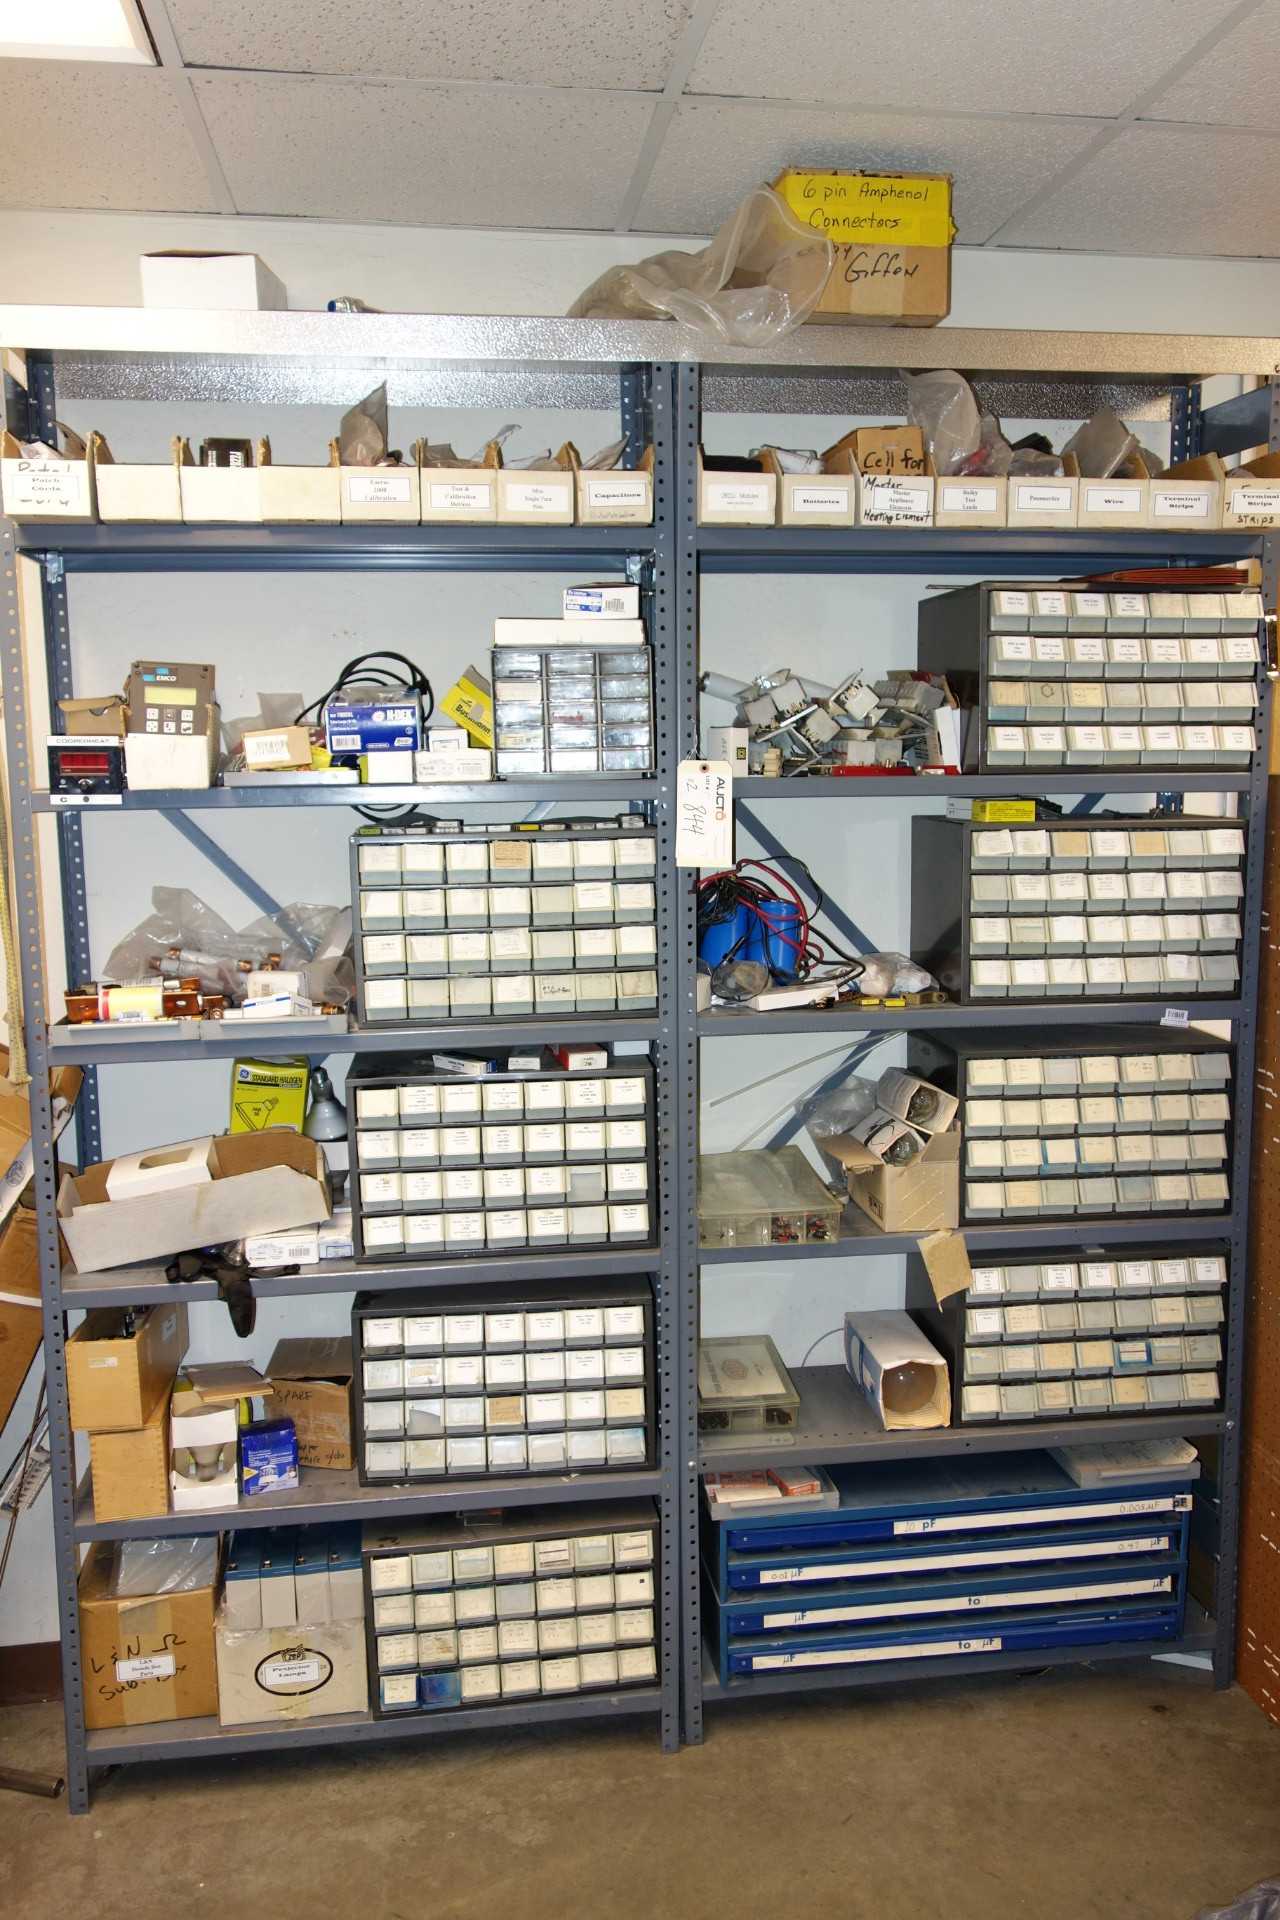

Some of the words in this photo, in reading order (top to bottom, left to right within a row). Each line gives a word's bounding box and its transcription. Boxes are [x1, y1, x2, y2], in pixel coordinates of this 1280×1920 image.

[803, 178, 817, 199] 6
[824, 182, 847, 202] pin
[859, 182, 929, 201] Amphenol
[809, 208, 901, 229] Connectors
[863, 450, 894, 469] Cell
[900, 448, 926, 470] for
[922, 1518, 937, 1531] pF
[967, 1595, 981, 1606] to
[957, 1640, 972, 1650] to
